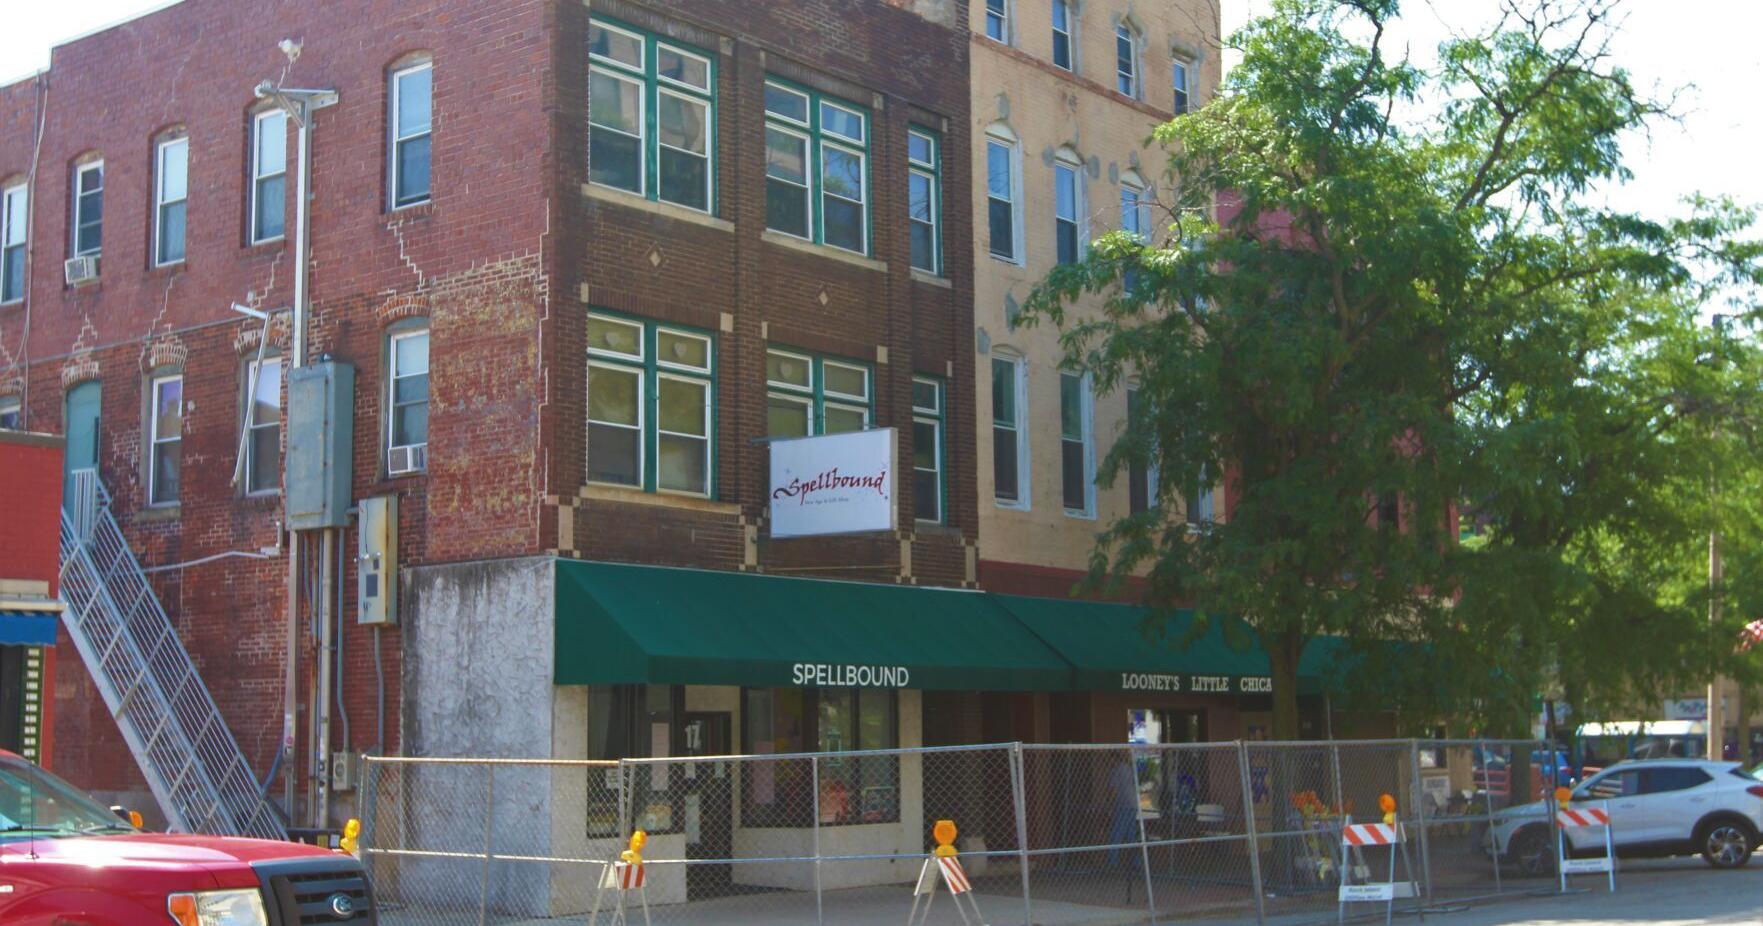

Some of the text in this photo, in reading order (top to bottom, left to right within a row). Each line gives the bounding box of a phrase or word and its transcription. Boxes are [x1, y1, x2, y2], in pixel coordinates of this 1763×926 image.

[773, 467, 886, 506] Spellbound
[792, 663, 910, 688] SPELLBOUND
[1122, 673, 1180, 691] LOONEY'S
[1191, 676, 1229, 692] LITTLE
